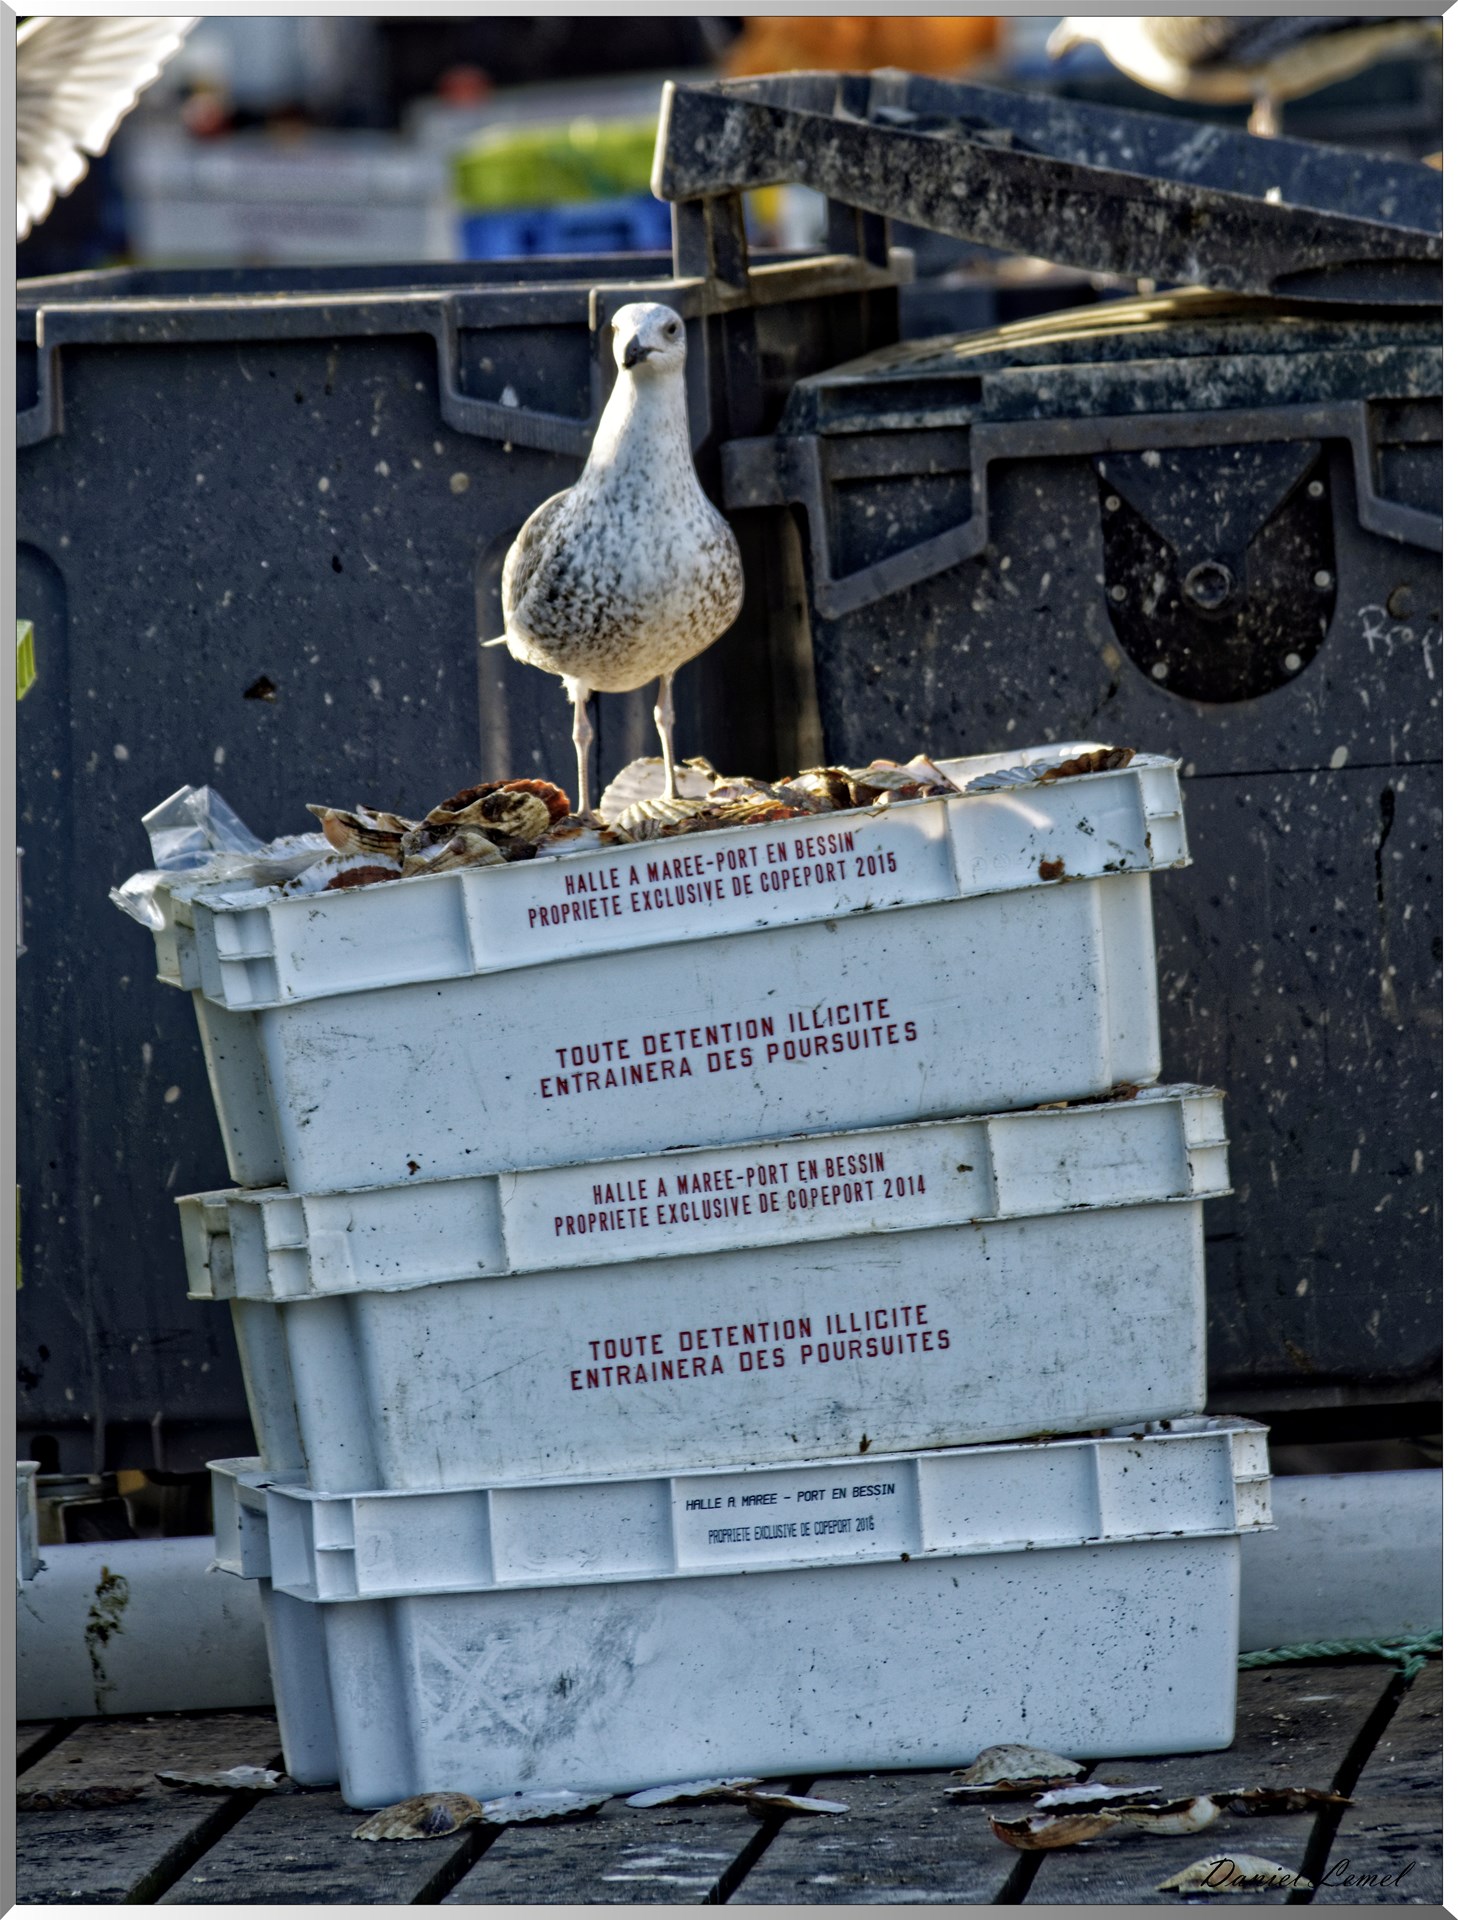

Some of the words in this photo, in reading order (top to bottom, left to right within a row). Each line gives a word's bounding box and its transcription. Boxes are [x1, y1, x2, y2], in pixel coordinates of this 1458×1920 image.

[528, 894, 622, 928] PROPRIETE
[632, 880, 725, 912] EXCLUSIVE
[733, 875, 752, 896] DE
[761, 861, 847, 892] COPEPORT
[856, 852, 897, 878] 2015
[565, 866, 620, 896] HALLE
[629, 867, 639, 885] A
[648, 846, 759, 882] MAREE-PORT
[767, 842, 787, 862] EN
[795, 831, 855, 860] BESSIN
[540, 1060, 692, 1099] ENTRAINERA
[708, 1047, 754, 1073] DES
[767, 1021, 918, 1064] POURSUITES
[556, 1039, 629, 1069] TOUTE
[643, 1016, 774, 1056] DETENTION
[789, 999, 891, 1032] ILLICITE
[555, 1206, 649, 1237] PROPRIETE
[658, 1195, 751, 1225] EXCLUSIVE
[760, 1193, 780, 1214] DE
[787, 1181, 874, 1210] COPEPORT
[885, 1175, 926, 1199] 2014
[593, 1180, 648, 1205] HALLE
[658, 1178, 668, 1197] A
[677, 1163, 789, 1195] MAREE-PORT
[798, 1160, 818, 1182] EN
[826, 1152, 885, 1177] BESSIN
[570, 1355, 724, 1390] ENTRAINERA
[740, 1348, 784, 1372] DES
[801, 1329, 950, 1365] POURSUITES
[589, 1335, 663, 1361] TOUTE
[680, 1318, 811, 1352] DETENTION
[826, 1305, 928, 1335] ILLICITE
[686, 1498, 722, 1510] HALLE
[728, 1497, 735, 1507] A
[742, 1493, 777, 1506] MAREE
[797, 1490, 826, 1502] PORT
[832, 1488, 846, 1499] EN
[852, 1484, 895, 1498] BESSIN
[709, 1527, 750, 1544] PROPRIETE
[754, 1523, 797, 1540] EXCLUSIVE
[801, 1522, 810, 1536] DE
[814, 1519, 851, 1536] COPEPORT
